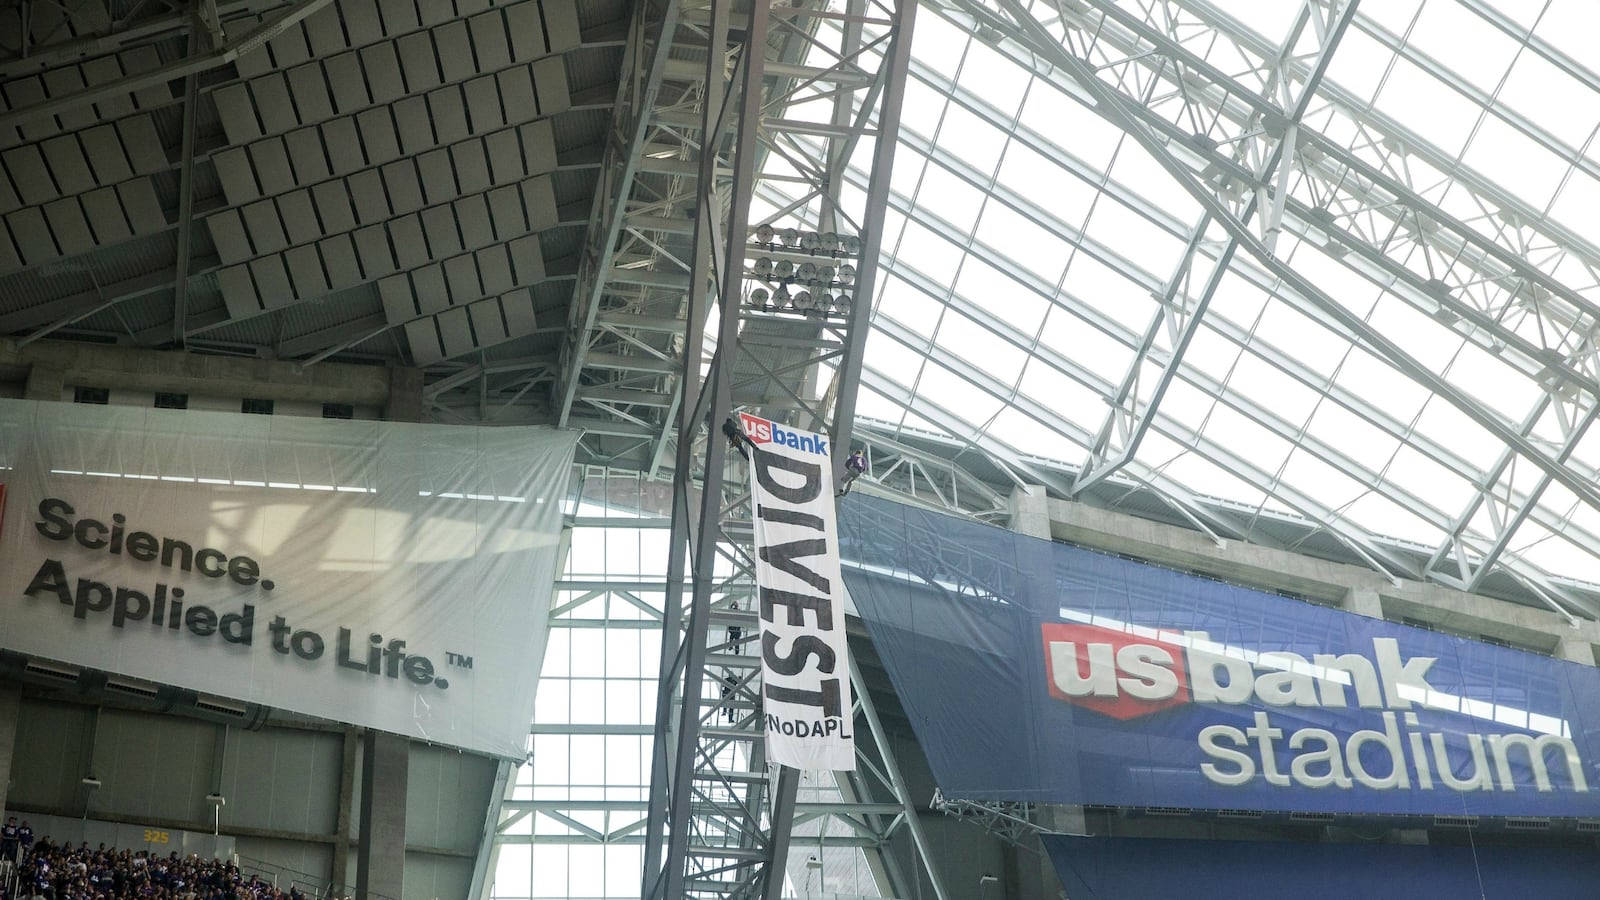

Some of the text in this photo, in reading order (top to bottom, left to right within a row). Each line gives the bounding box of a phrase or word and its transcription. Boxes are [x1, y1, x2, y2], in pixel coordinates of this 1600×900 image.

[35, 497, 275, 591] Science.
[753, 449, 842, 718] DIVEST
[23, 557, 256, 648] Applied
[268, 613, 325, 661] to
[1198, 711, 1589, 793] stadium
[143, 829, 169, 844] 325
